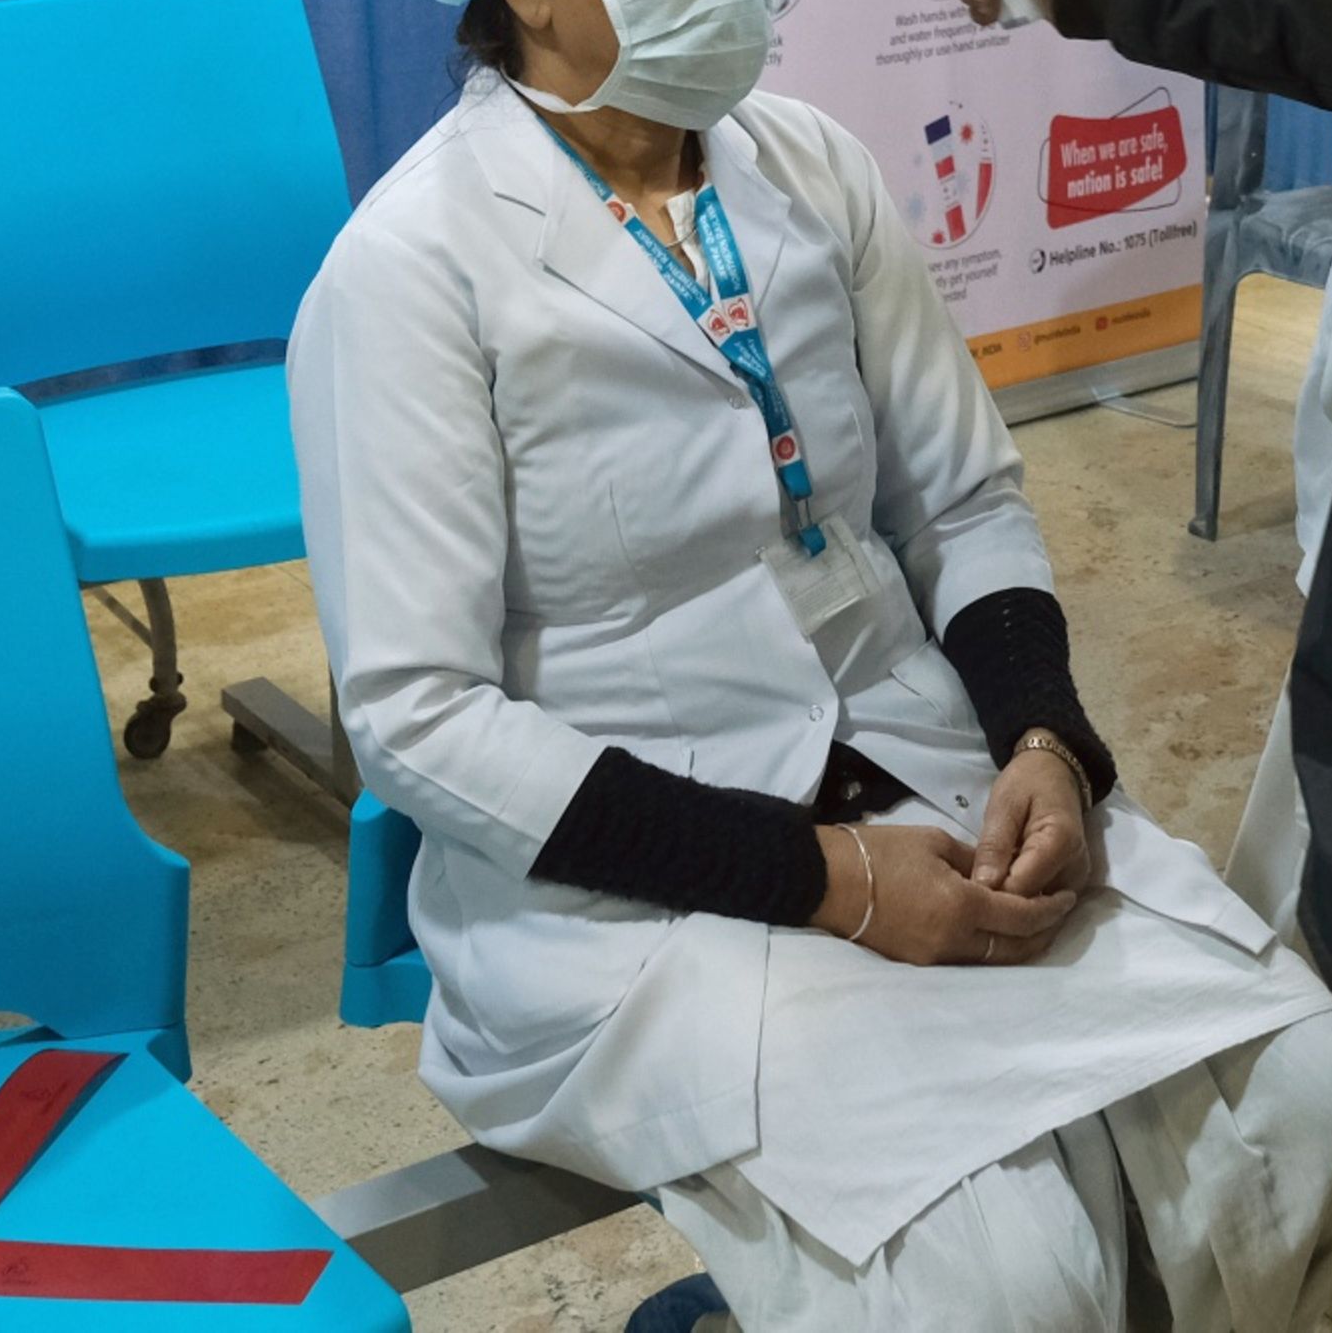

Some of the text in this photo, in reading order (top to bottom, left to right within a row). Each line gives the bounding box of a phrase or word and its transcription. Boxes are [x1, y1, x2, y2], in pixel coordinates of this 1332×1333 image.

[920, 10, 947, 23] hands
[875, 35, 1010, 65] thoroughly or use hand sanitizer
[890, 33, 906, 46] and
[908, 31, 932, 42] water
[934, 23, 977, 39] frequently
[1061, 123, 1167, 168] When we are safe,
[1067, 156, 1163, 199] nation is safe!
[1049, 244, 1096, 266] Helpline
[1124, 233, 1146, 249] 1075
